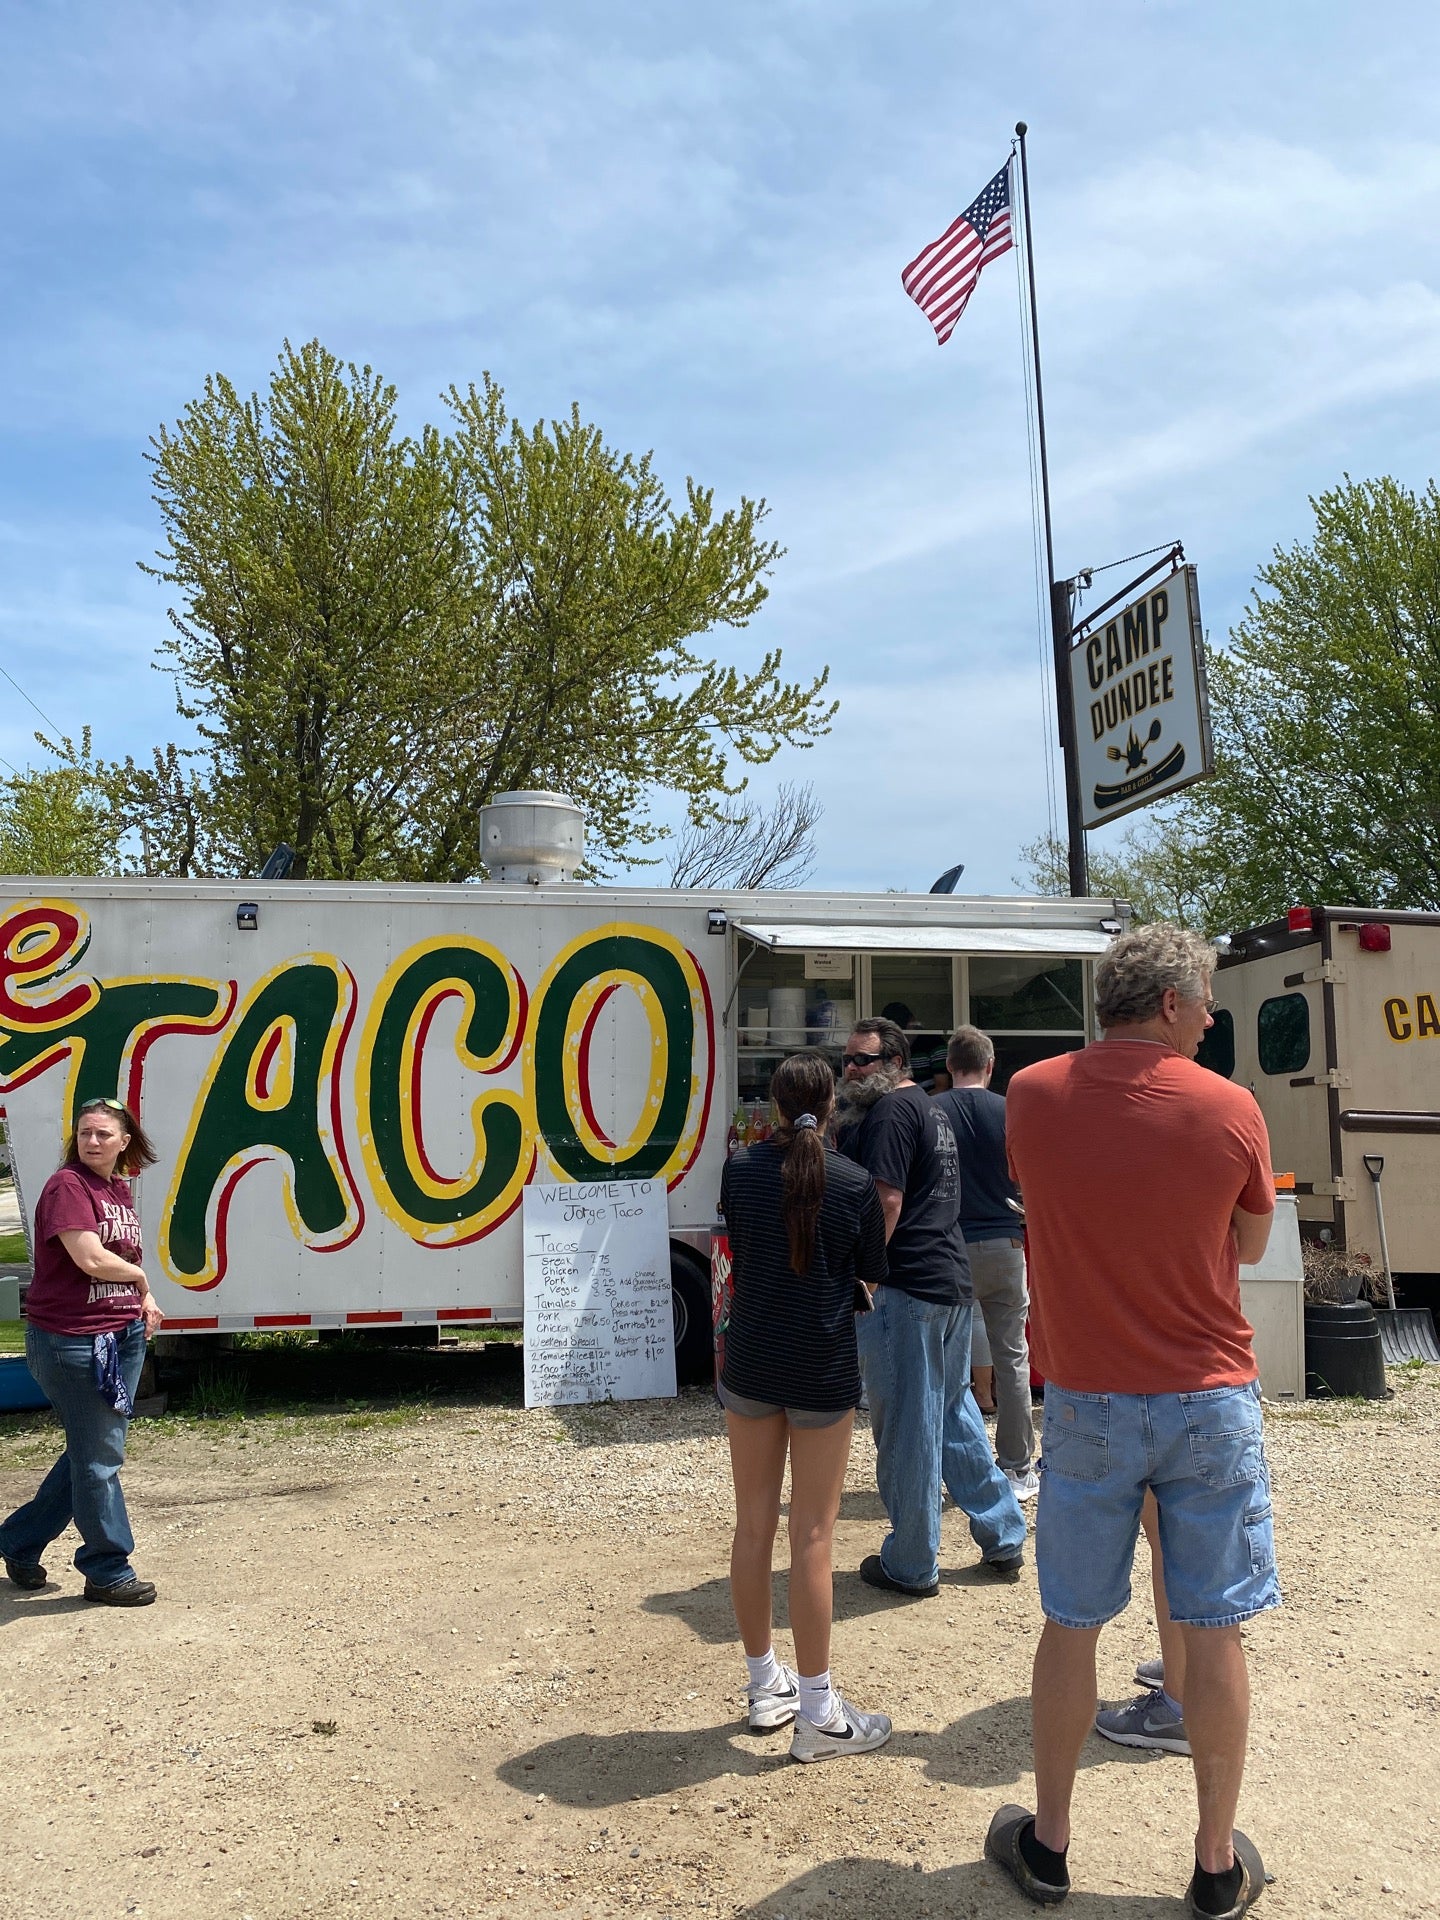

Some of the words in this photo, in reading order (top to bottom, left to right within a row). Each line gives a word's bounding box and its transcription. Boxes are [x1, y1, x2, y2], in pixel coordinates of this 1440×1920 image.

[1086, 588, 1169, 691] CAMP
[1090, 655, 1174, 742] DUNDEE
[0, 922, 715, 1290] TACO
[539, 1184, 620, 1204] WELCOME
[623, 1182, 652, 1198] TO
[563, 1204, 606, 1226] Jorge
[609, 1202, 644, 1219] Taco
[534, 1234, 579, 1252] Tacos
[541, 1267, 579, 1276] Chicken
[544, 1277, 566, 1287] Pork
[549, 1286, 580, 1298] Veggie
[593, 1288, 617, 1298] 3.50
[534, 1294, 577, 1309] Tamales
[538, 1312, 561, 1321] Pork
[574, 1317, 582, 1328] 2
[537, 1324, 570, 1333] Chicken
[612, 1319, 646, 1333] Jarritos
[530, 1337, 568, 1348] Weekend
[570, 1335, 600, 1348] Special
[531, 1352, 540, 1361] 2
[531, 1364, 539, 1374] 2
